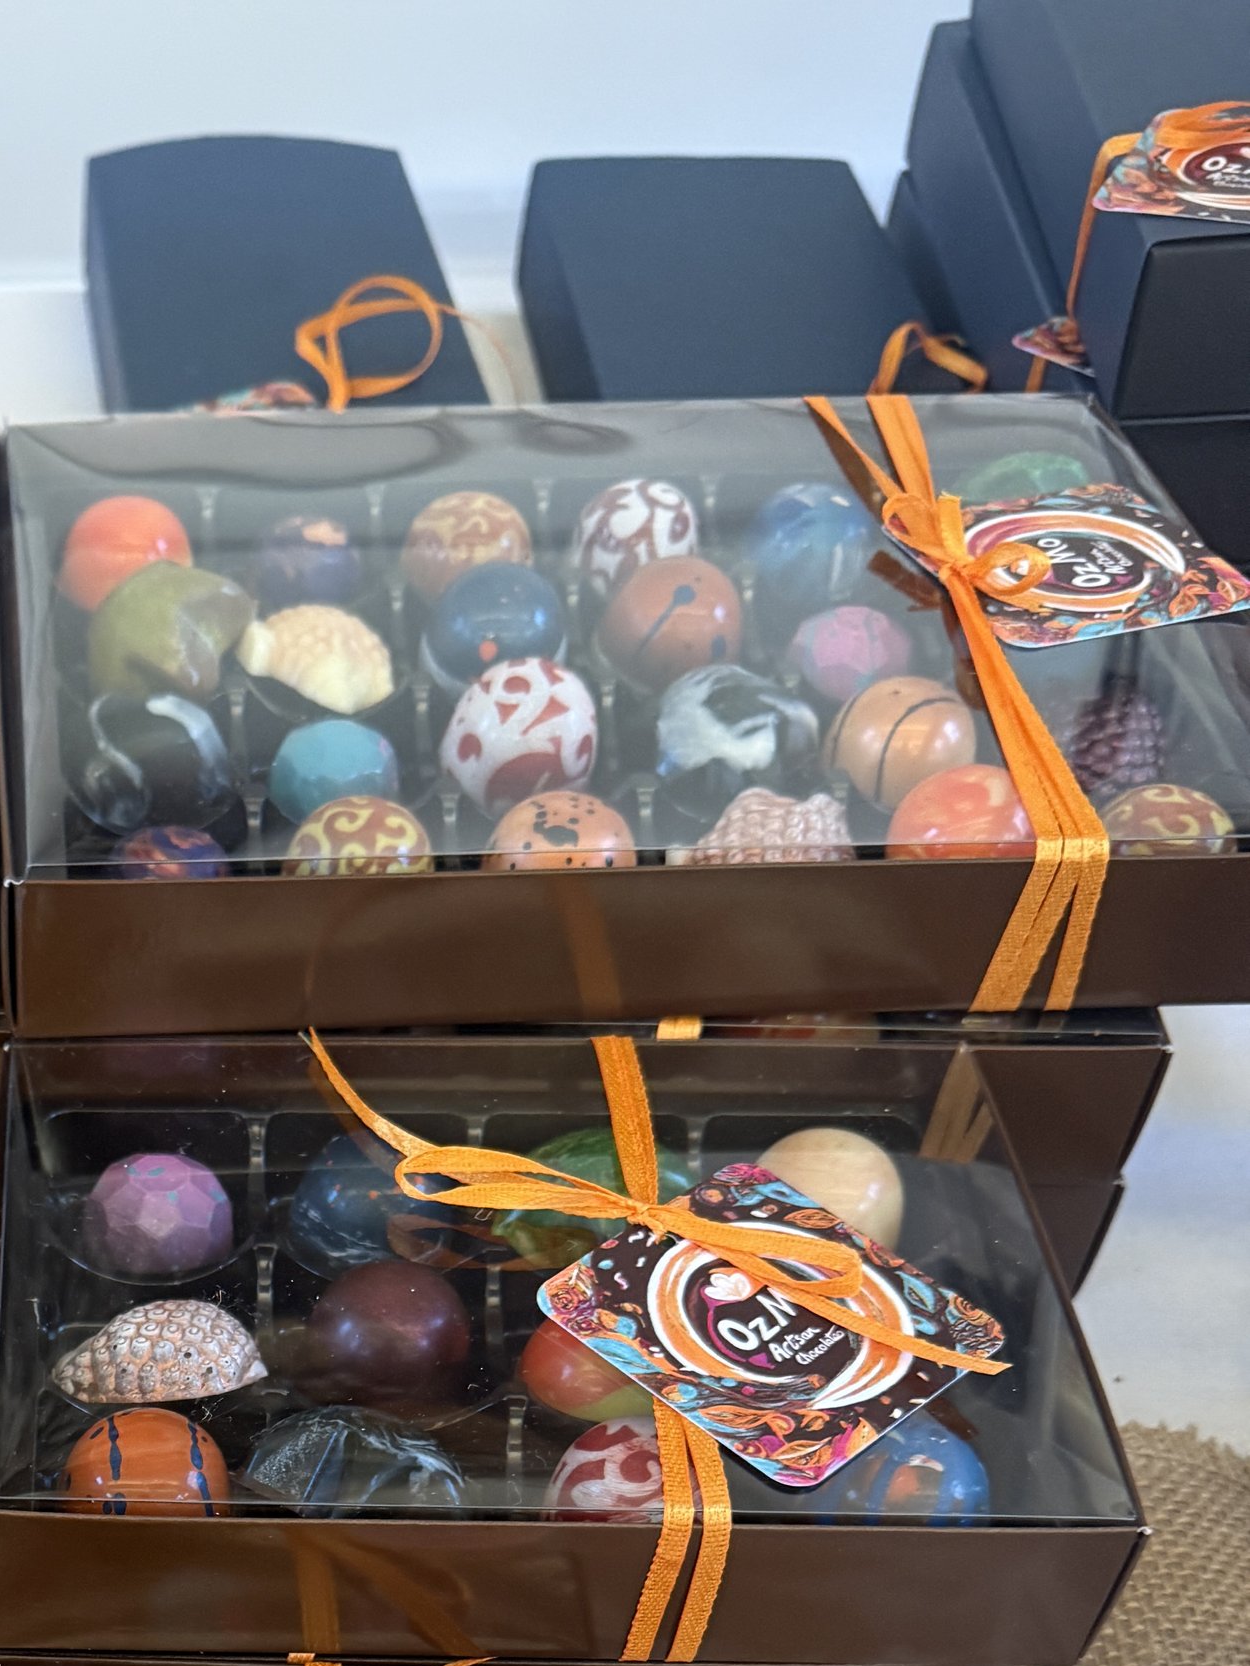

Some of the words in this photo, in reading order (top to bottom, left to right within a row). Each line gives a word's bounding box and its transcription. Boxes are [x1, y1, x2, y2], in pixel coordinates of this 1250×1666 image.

[1201, 156, 1250, 174] Oz
[1037, 538, 1111, 587] OzMo
[717, 1287, 797, 1351] OzM
